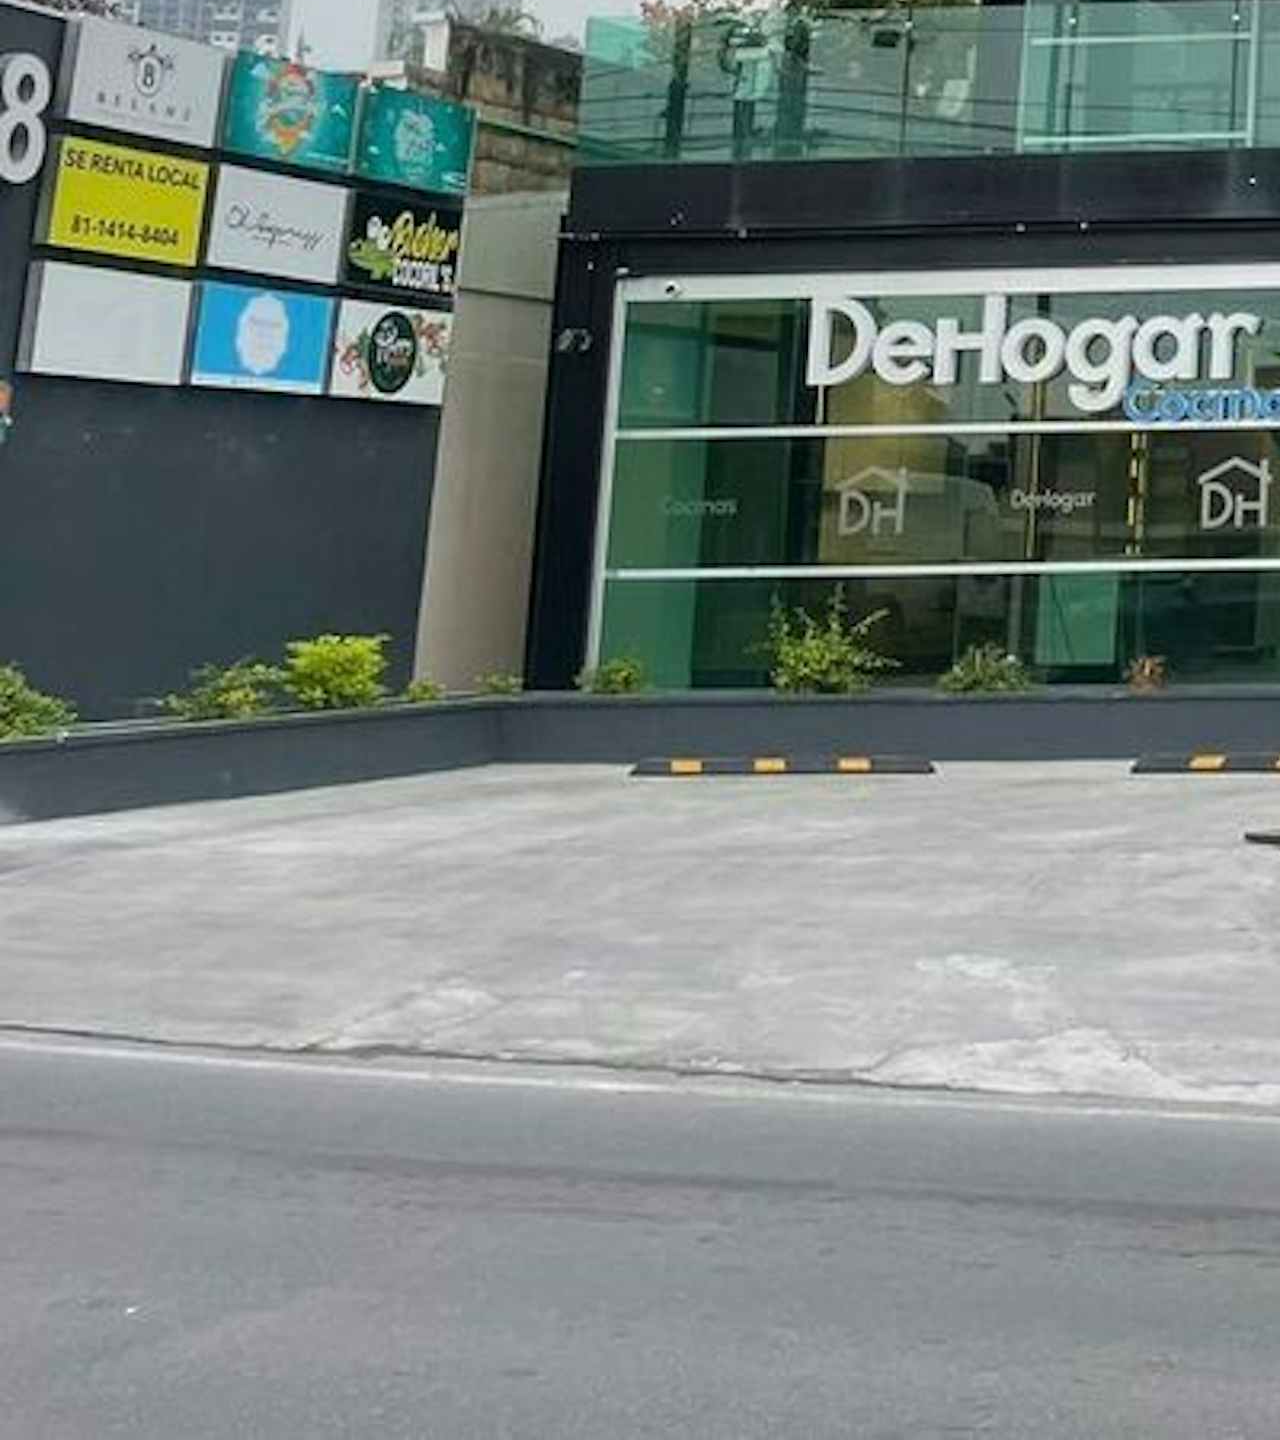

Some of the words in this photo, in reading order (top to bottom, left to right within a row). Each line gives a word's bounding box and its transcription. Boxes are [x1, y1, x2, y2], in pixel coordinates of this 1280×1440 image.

[64, 150, 88, 170] SE
[93, 152, 145, 180] RENTA
[147, 163, 200, 190] LOCAL
[806, 293, 1262, 412] DeHogar
